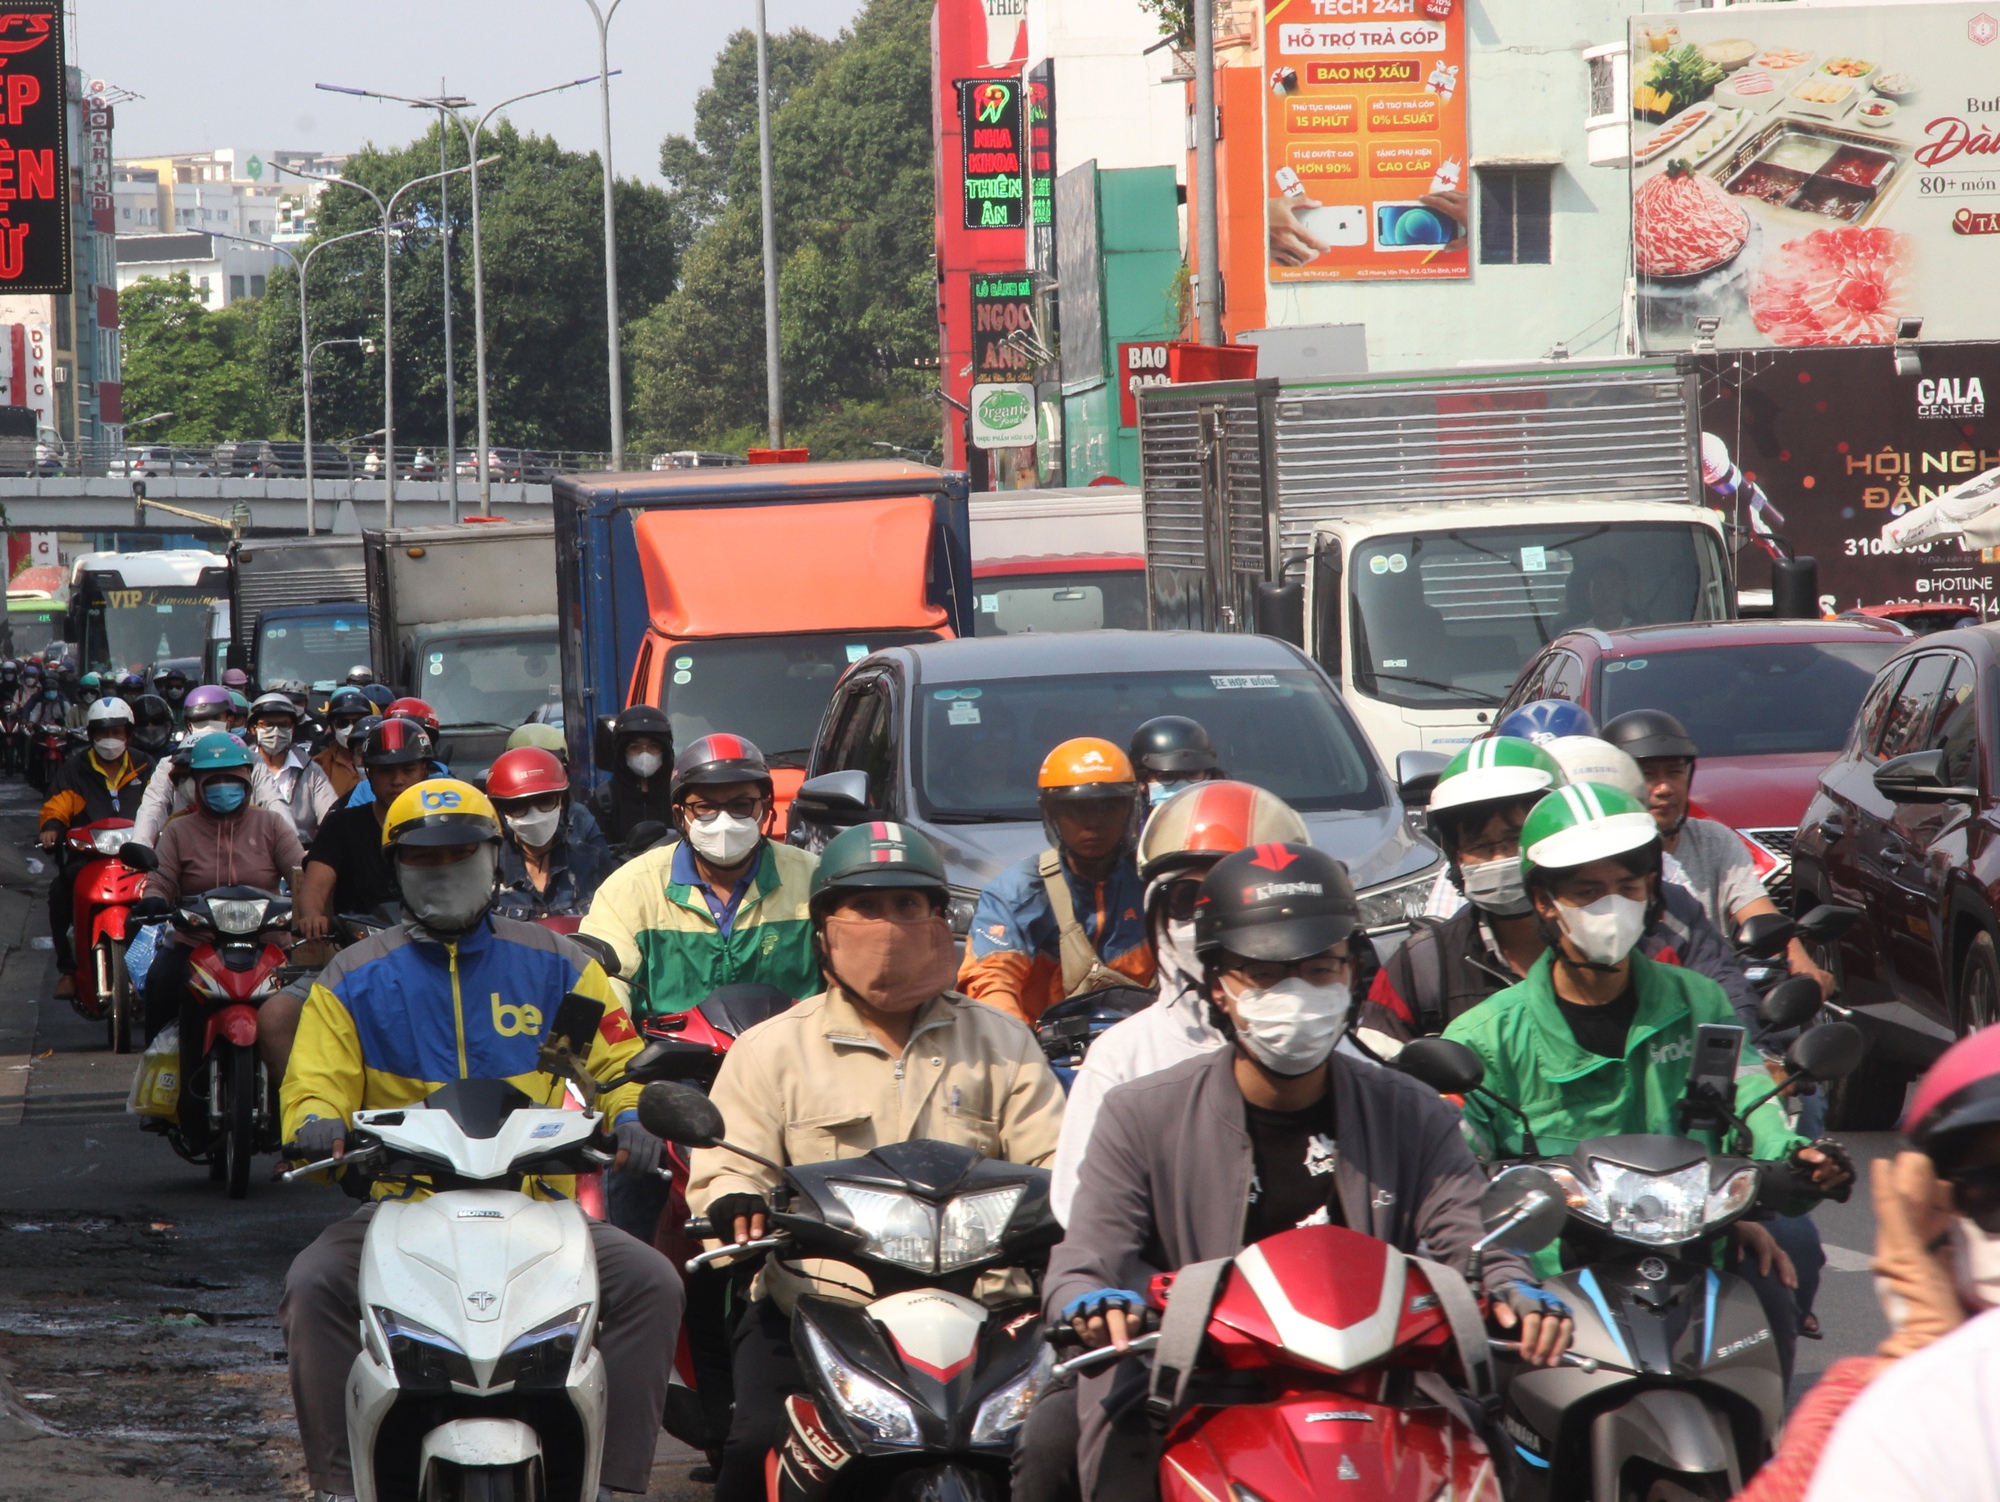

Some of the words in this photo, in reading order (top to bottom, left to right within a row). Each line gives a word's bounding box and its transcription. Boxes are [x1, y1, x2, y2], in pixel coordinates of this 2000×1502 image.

[1311, 0, 1366, 15] TECH
[1373, 0, 1414, 14] 24H
[1427, 4, 1449, 15] SALE
[1288, 29, 1315, 48] HỖ
[1320, 31, 1355, 50] TRỢ
[1360, 27, 1395, 46] TRẢ
[1400, 29, 1439, 45] GÓP
[1317, 68, 1350, 80] BAO
[1353, 66, 1376, 82] NỢ
[1380, 63, 1411, 79] XẤU
[1296, 116, 1309, 127] 15
[1312, 113, 1349, 127] PHÚT
[1372, 115, 1391, 125] 0%
[974, 128, 1013, 149] NHA
[968, 152, 1019, 174] KHOA
[1325, 163, 1352, 173] 90%
[1377, 162, 1403, 172] CAO
[1405, 158, 1432, 172] CẤP
[967, 174, 1023, 199] THIÊN
[1920, 177, 1957, 194] 80+
[1961, 177, 1996, 191] món
[981, 200, 1008, 225] ÂN
[1128, 346, 1168, 369] BAO
[1917, 376, 1986, 406] GALA
[976, 402, 1031, 422] Organic
[1917, 403, 1985, 416] CENTER
[1846, 445, 1912, 482] HỘI
[1931, 576, 1993, 592] HOTLINE
[108, 590, 144, 609] VIP
[1214, 678, 1226, 687] XE
[421, 789, 462, 810] be
[491, 992, 543, 1038] be
[457, 1210, 504, 1219] HONDA
[907, 1296, 959, 1308] HONDA
[1717, 1329, 1770, 1358] SIRIUS
